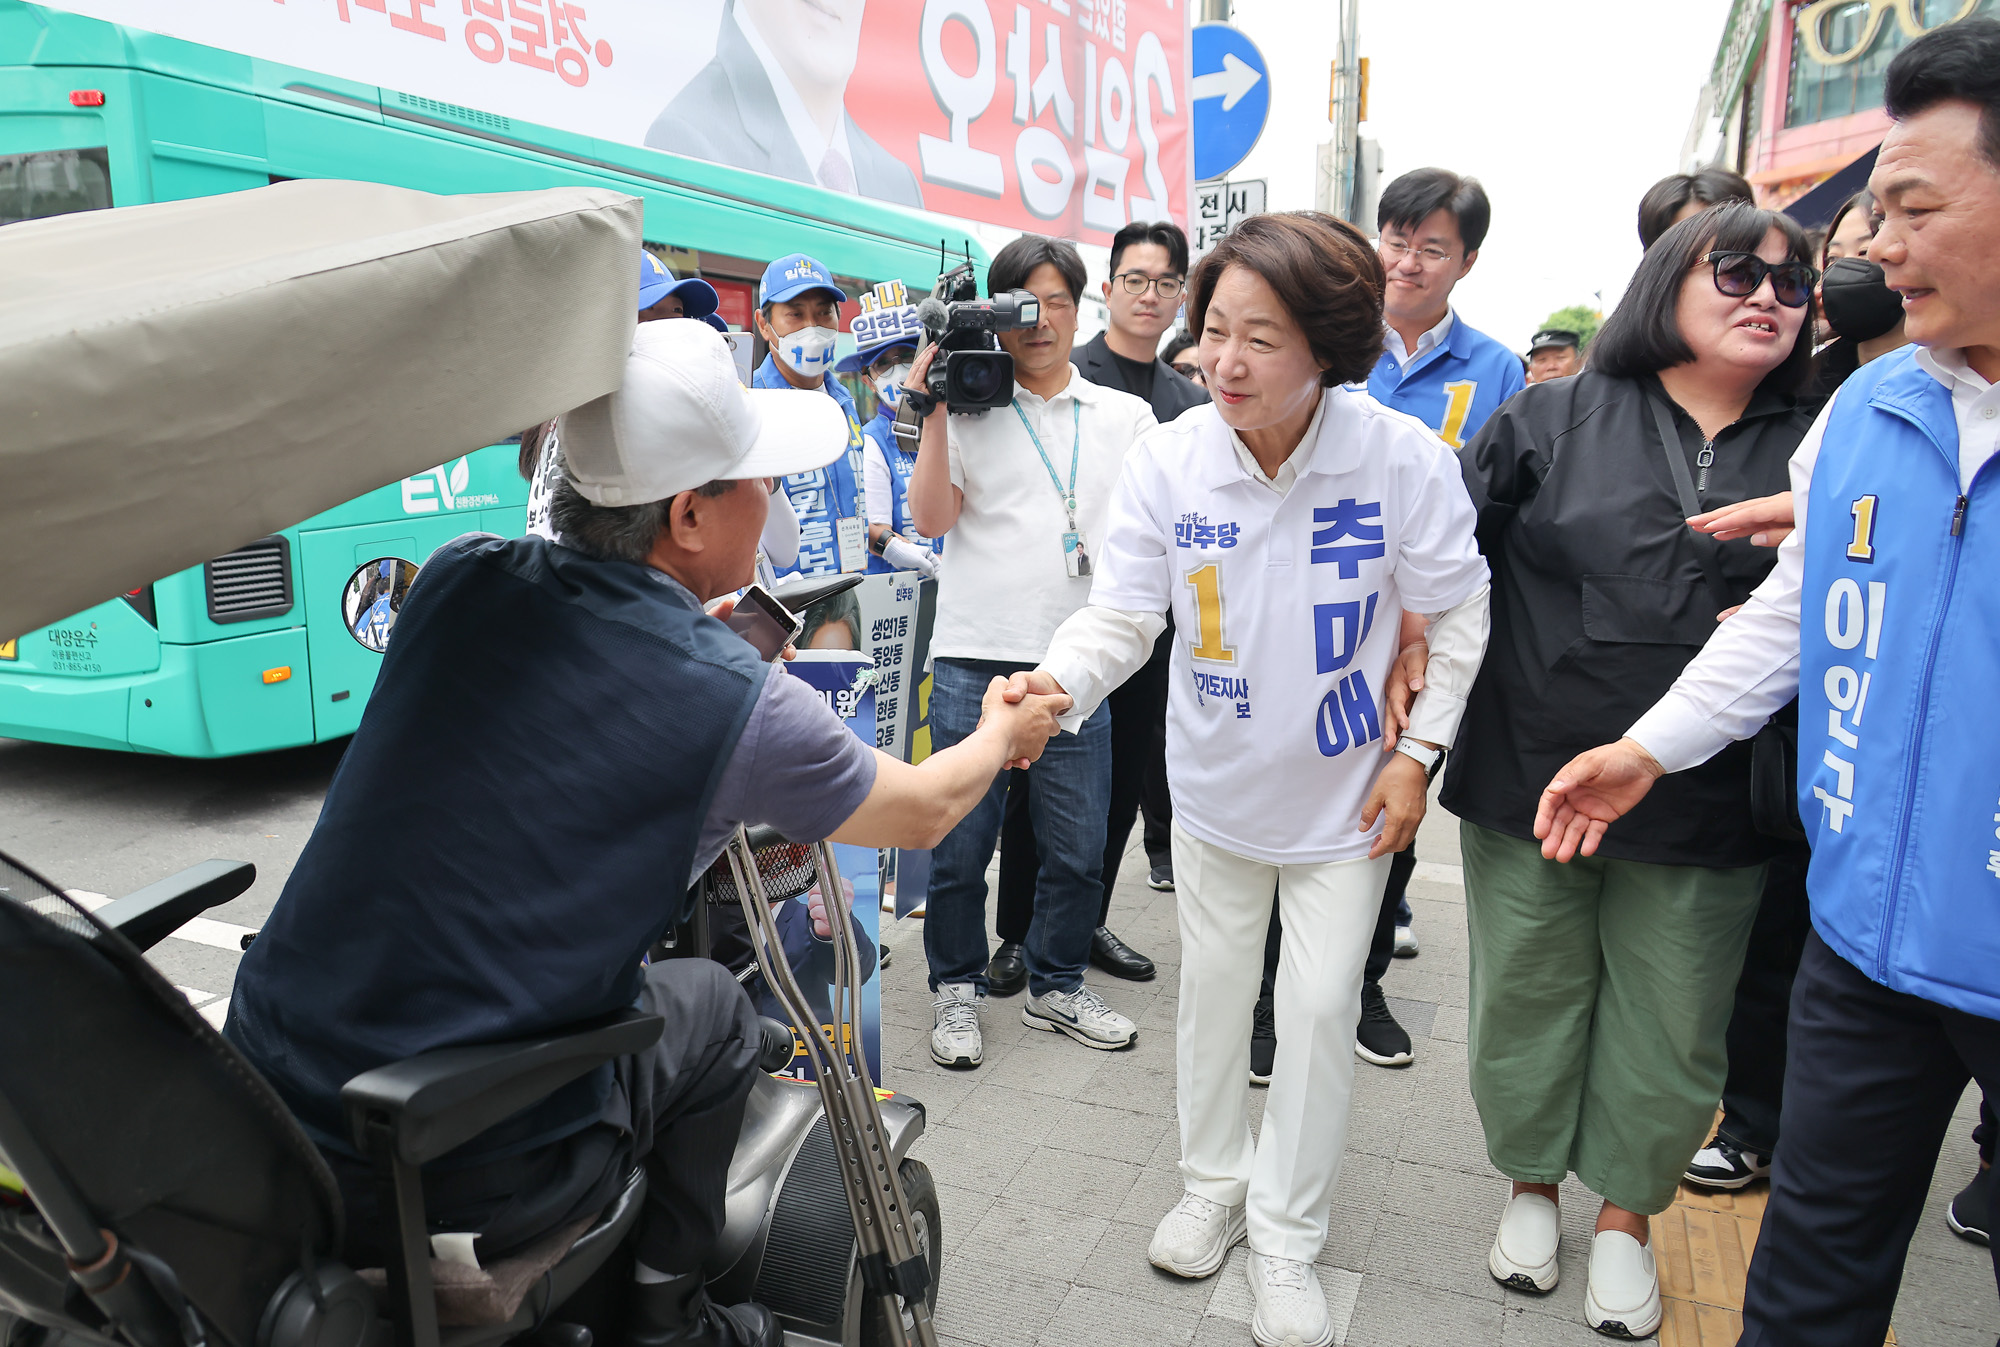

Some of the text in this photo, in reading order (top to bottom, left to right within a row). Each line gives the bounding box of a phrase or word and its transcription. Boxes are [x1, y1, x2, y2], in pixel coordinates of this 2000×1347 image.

[863, 283, 904, 313] 1-나
[1432, 379, 1478, 450] 1
[1181, 512, 1208, 525] 더불어
[1845, 494, 1880, 564] 1
[1174, 522, 1240, 549] 민주당
[896, 587, 914, 602] 민주당
[1183, 559, 1239, 667] 1
[48, 629, 98, 649] 대양운수
[871, 615, 908, 642] 생연1동
[1310, 498, 1386, 758] 추미애
[875, 670, 901, 696] 산동
[875, 696, 898, 723] 현동
[876, 724, 896, 748] 요동
